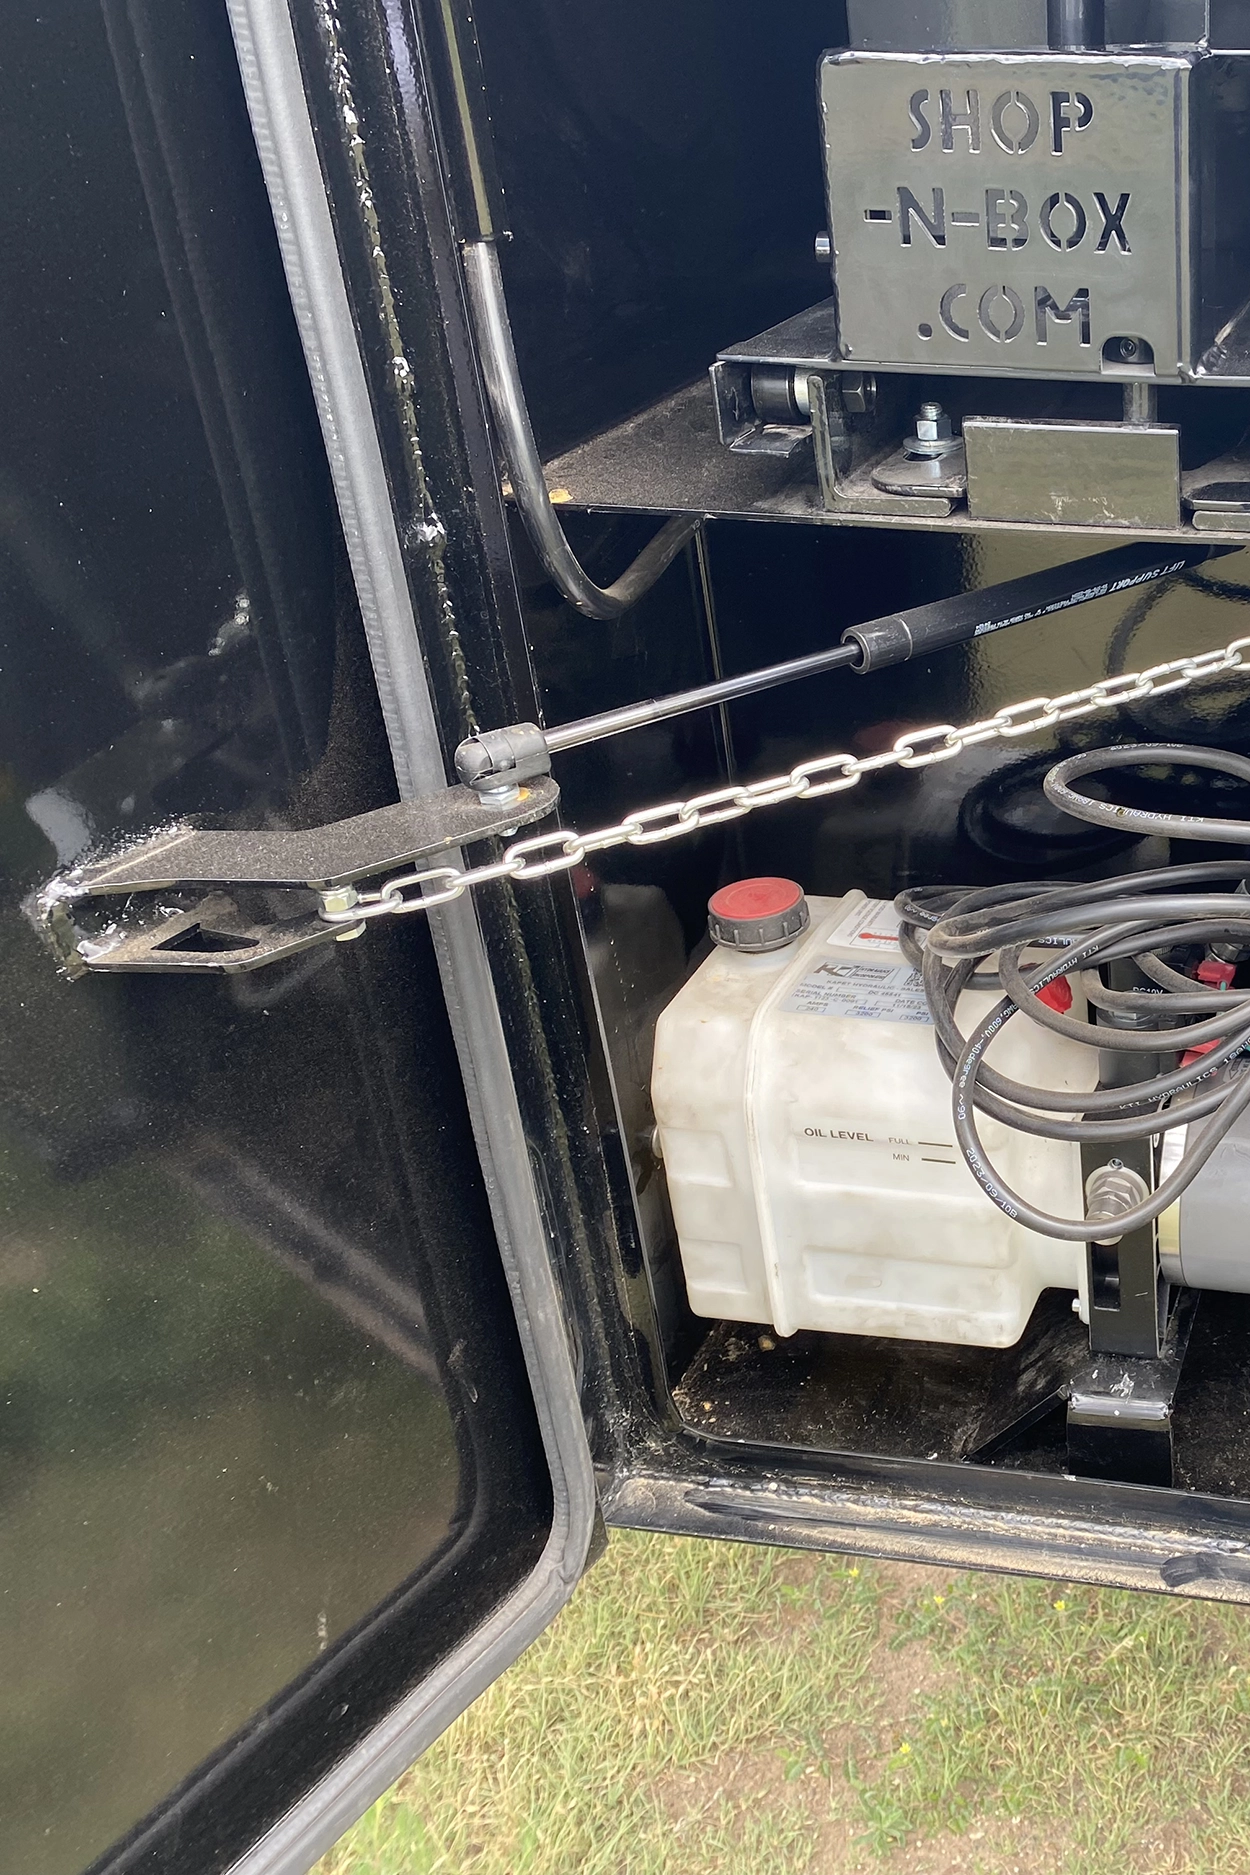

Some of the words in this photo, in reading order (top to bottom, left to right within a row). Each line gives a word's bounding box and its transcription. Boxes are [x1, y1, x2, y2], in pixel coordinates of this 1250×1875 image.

[909, 89, 1094, 156] SHOP
[864, 186, 1132, 255] -N-BOX
[917, 283, 1091, 347] .COM
[1109, 568, 1161, 592] SUPPORT
[1159, 560, 1186, 577] LIFT
[1082, 944, 1099, 959] KTI
[1148, 1066, 1218, 1103] HYDRAULICS
[804, 1127, 827, 1138] OIL
[830, 1129, 874, 1142] LEVEL
[888, 1137, 912, 1146] FULL
[892, 1153, 910, 1162] MIN
